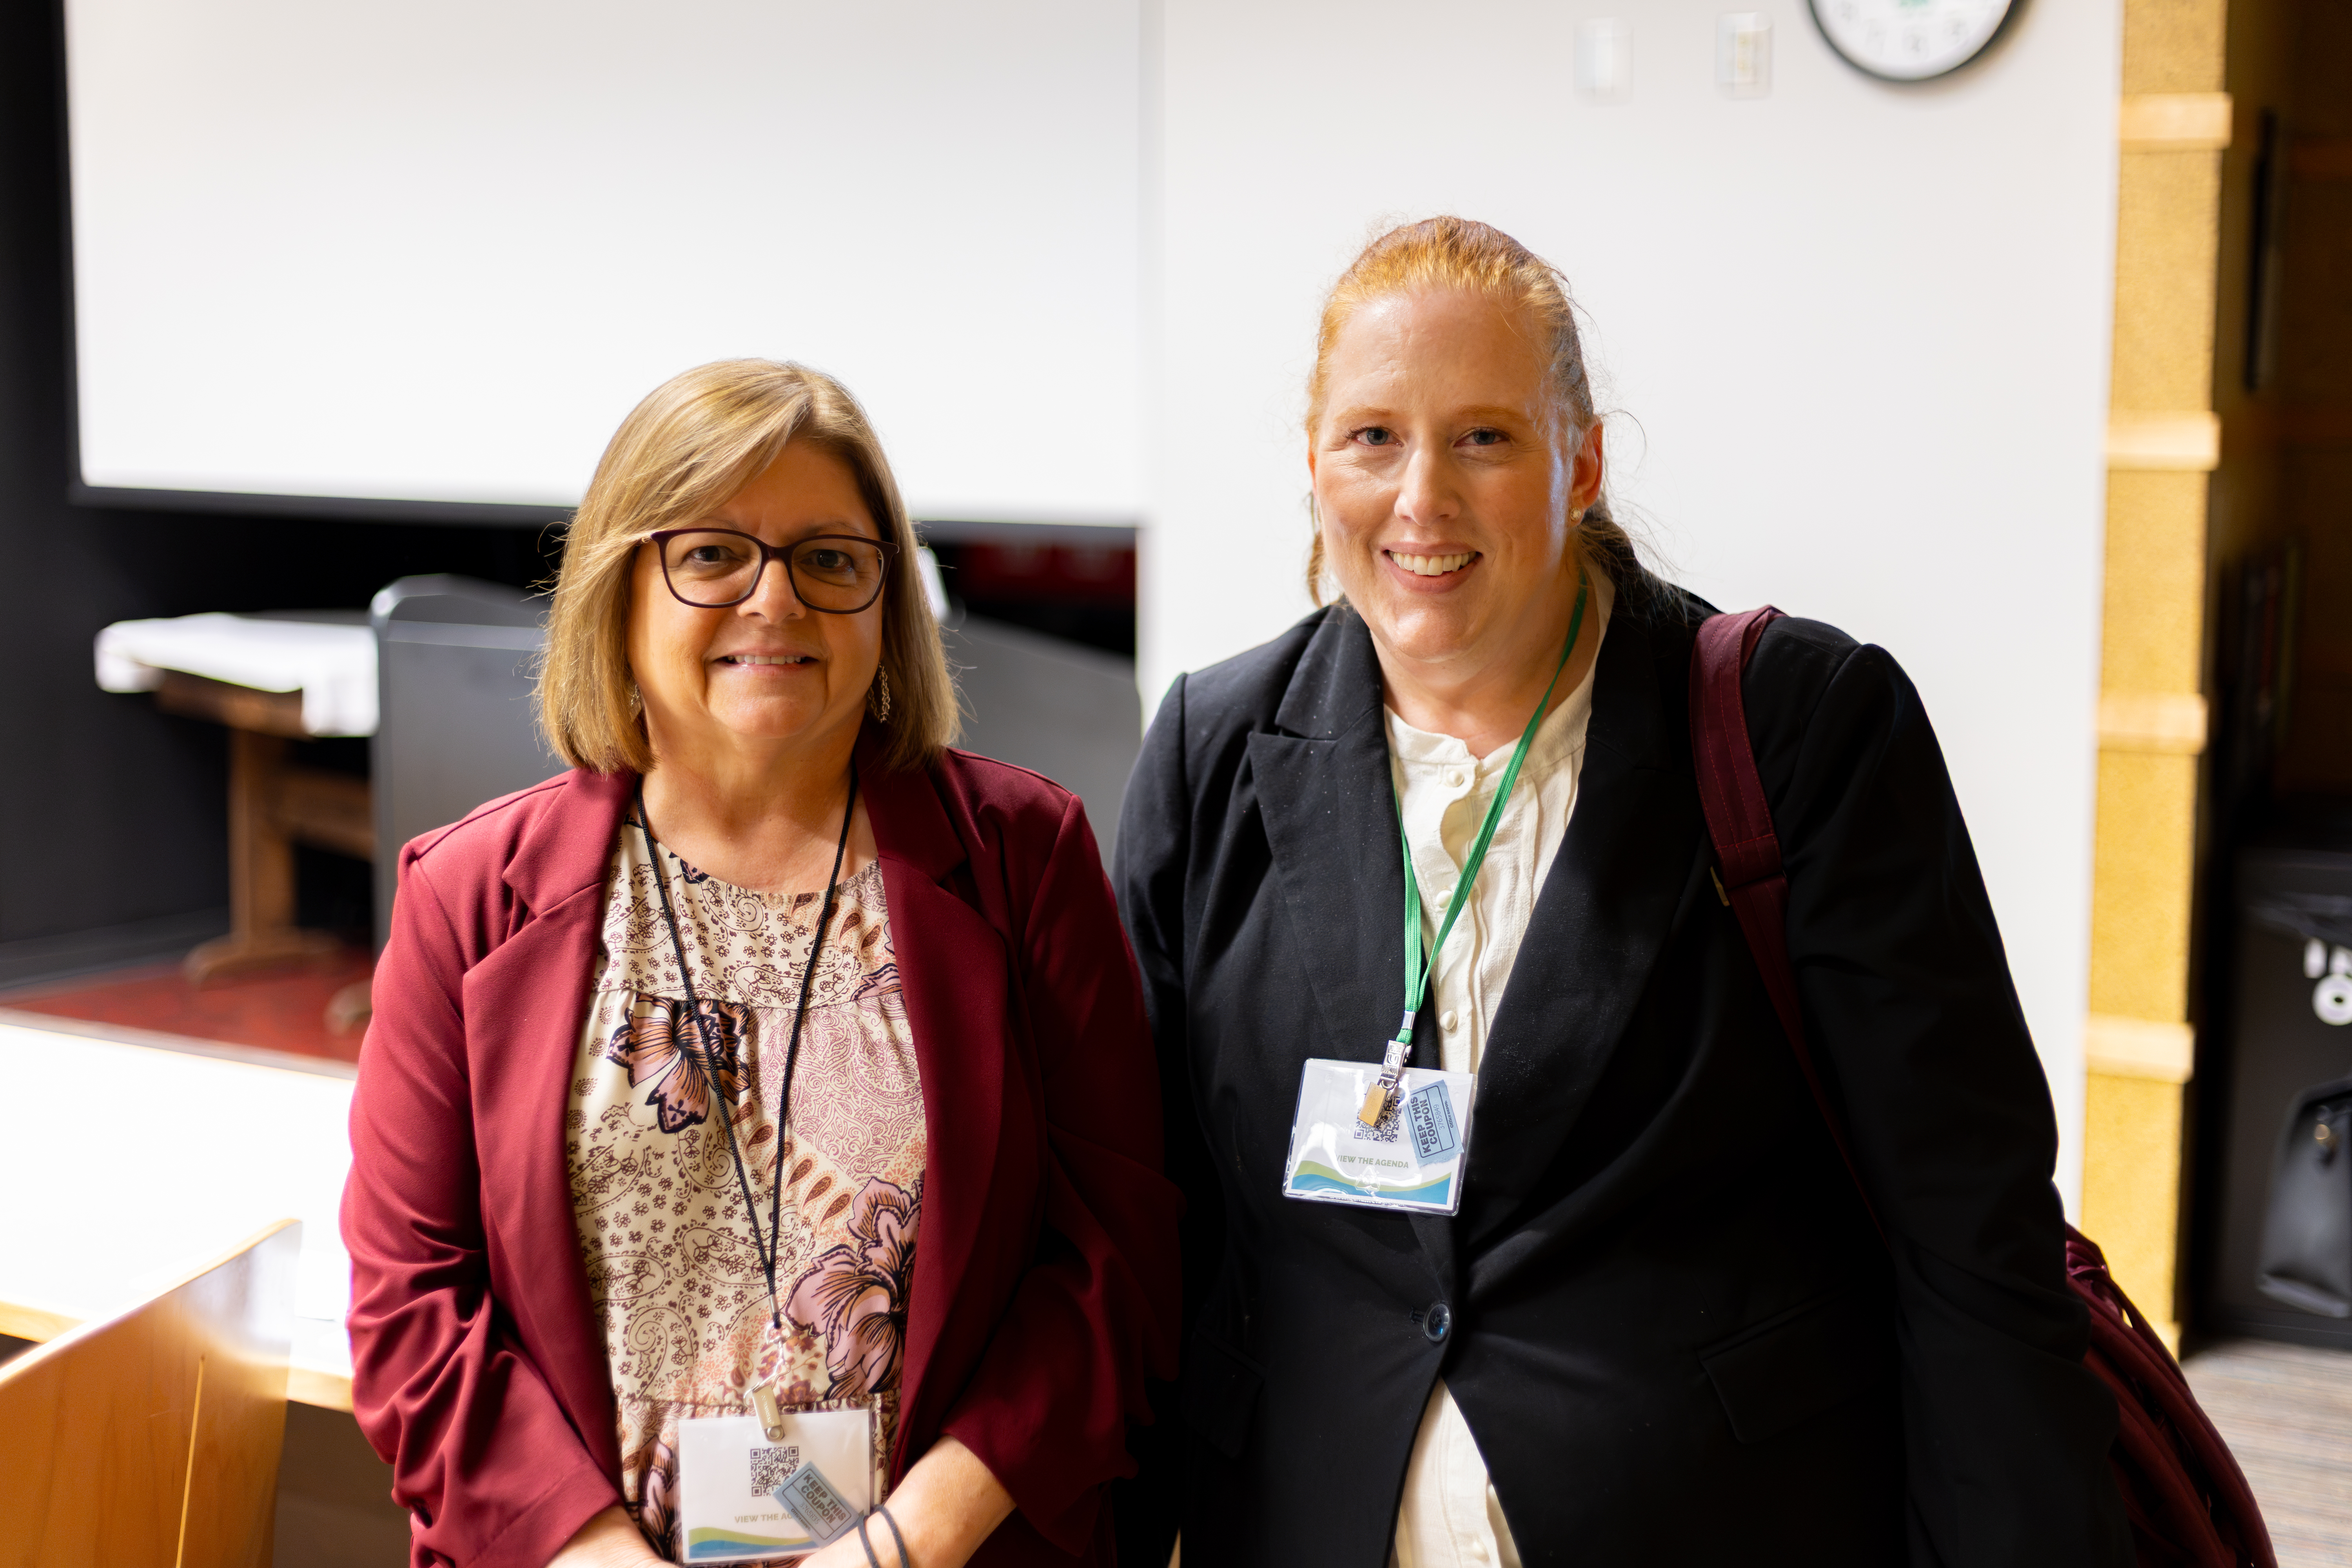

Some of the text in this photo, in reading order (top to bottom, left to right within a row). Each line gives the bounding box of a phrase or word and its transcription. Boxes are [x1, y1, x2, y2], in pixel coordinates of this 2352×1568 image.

[1411, 1096, 1431, 1153] KEEP THIS
[1419, 1099, 1437, 1144] COUPON
[1433, 1104, 1445, 1130] 3765849
[1375, 1159, 1408, 1168] AGENDA
[801, 1485, 836, 1523] COUPON
[803, 1474, 846, 1521] KEEP THIS
[734, 1515, 758, 1523] VIEW
[760, 1513, 779, 1521] THE
